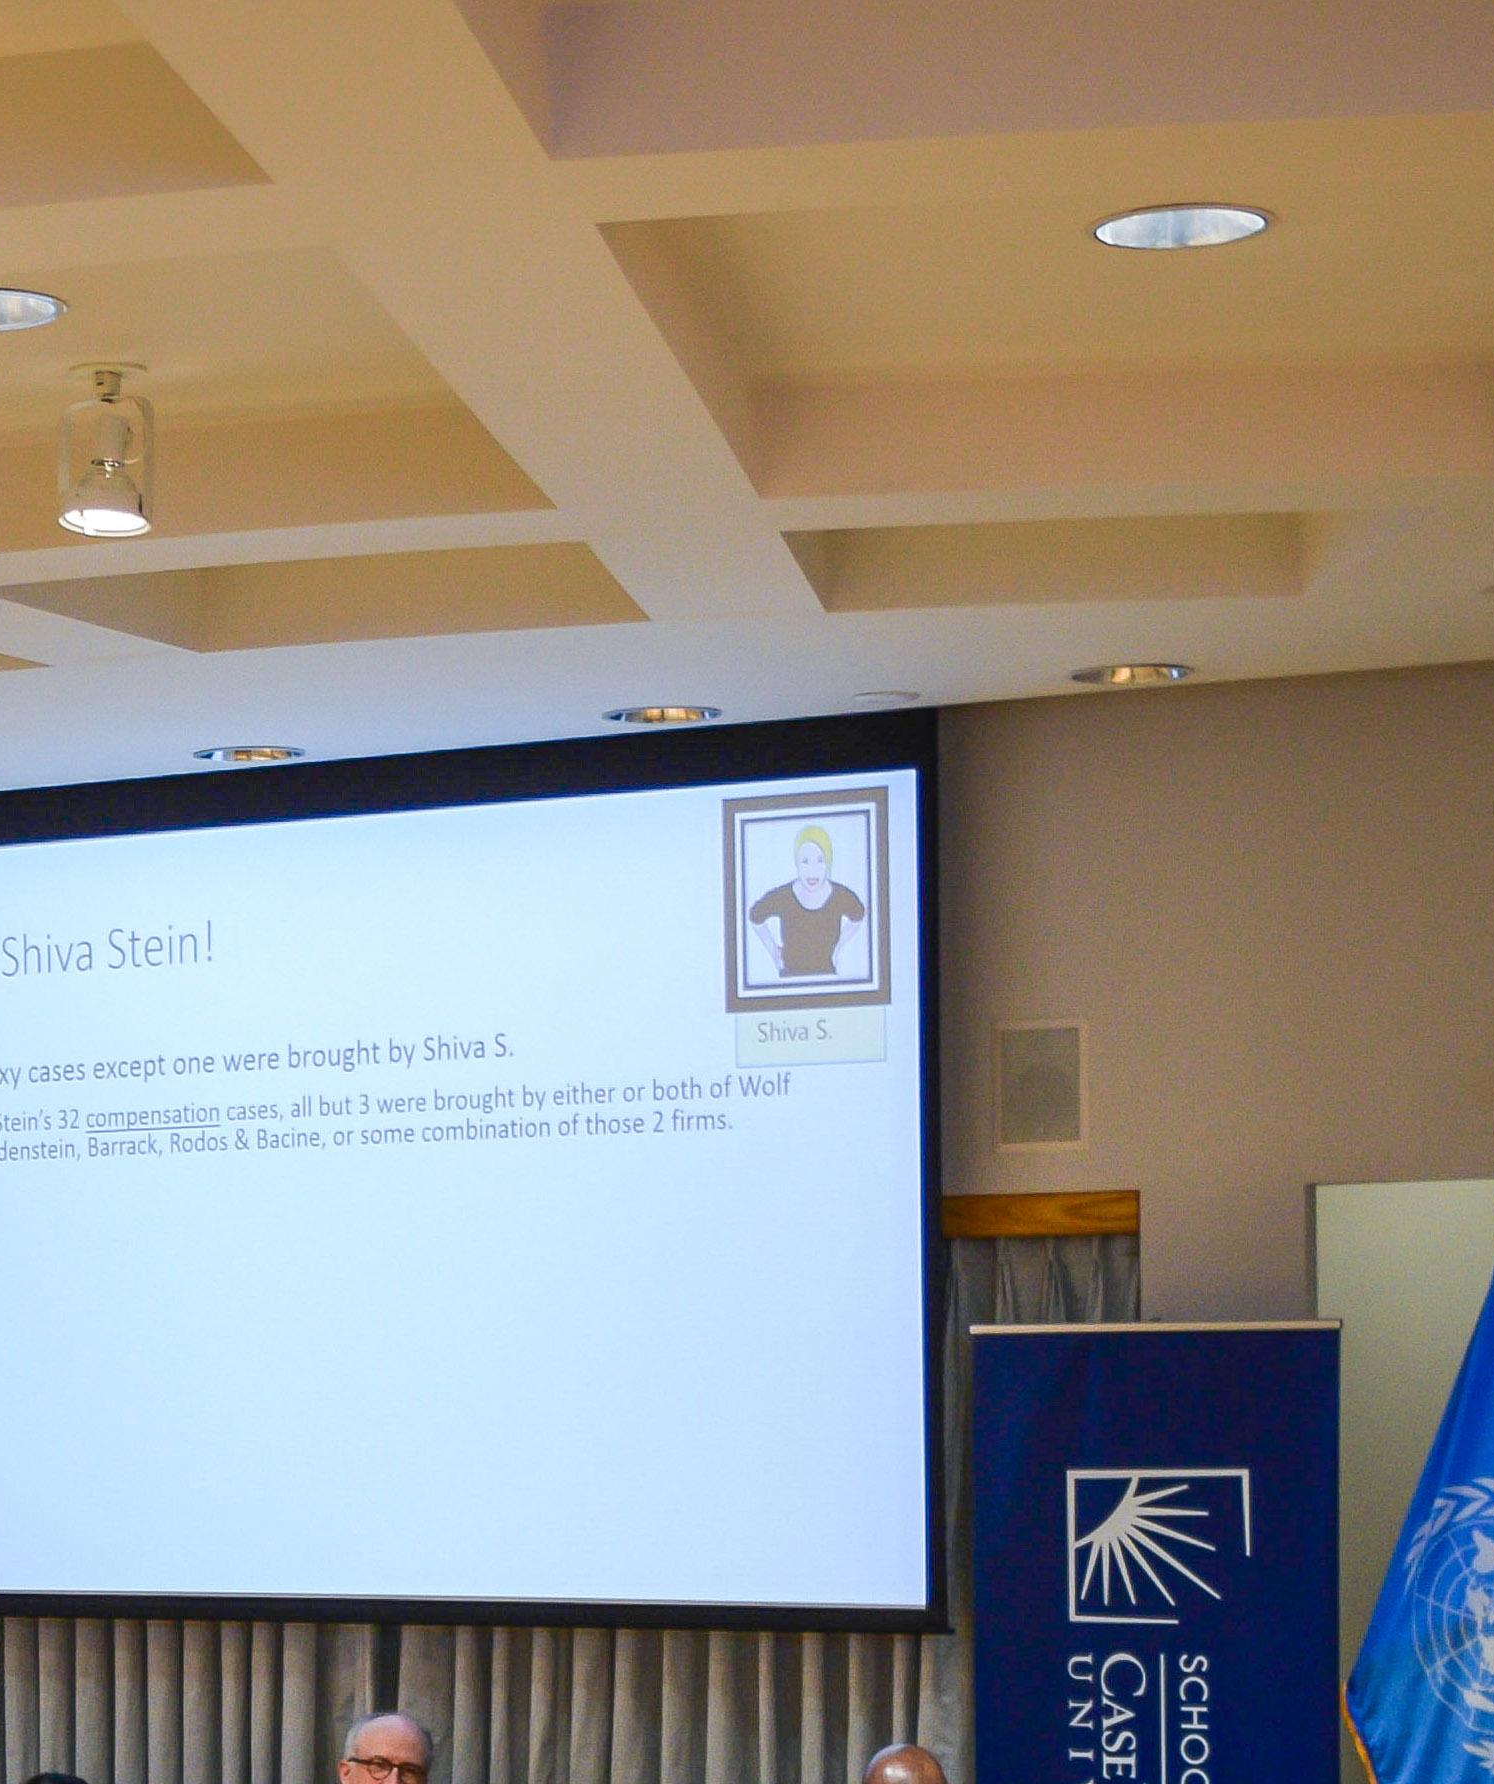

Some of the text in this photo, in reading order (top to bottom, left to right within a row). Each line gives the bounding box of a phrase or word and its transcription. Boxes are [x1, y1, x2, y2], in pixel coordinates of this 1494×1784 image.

[1, 933, 93, 977] Shiva
[107, 919, 212, 969] Stein!
[757, 1018, 834, 1043] Shiva S.
[28, 1062, 86, 1083] cases
[92, 1054, 166, 1082] except
[172, 1055, 215, 1075] one
[223, 1051, 280, 1073] were
[288, 1040, 380, 1072] brought
[389, 1038, 415, 1069] by
[422, 1035, 486, 1062] Shiva
[494, 1033, 514, 1058] S.
[58, 1109, 80, 1130] 32
[86, 1102, 220, 1131] compensation
[226, 1102, 284, 1122] cases,
[290, 1096, 312, 1118] all
[319, 1095, 351, 1116] but
[358, 1094, 370, 1114] 3
[376, 1095, 427, 1113] were
[433, 1086, 515, 1113] brought
[522, 1084, 547, 1111] by
[553, 1082, 616, 1105] either
[622, 1085, 646, 1102] or
[652, 1077, 702, 1101] both
[710, 1075, 732, 1098] of
[738, 1072, 791, 1097] Wolf
[87, 1133, 163, 1158] Barrack,
[170, 1130, 228, 1153] Rodos
[234, 1127, 250, 1150] &
[256, 1127, 327, 1150] Bacine,
[333, 1129, 354, 1146] or
[360, 1127, 415, 1145] some
[421, 1117, 551, 1143] combination
[558, 1114, 580, 1137] of
[586, 1112, 645, 1136] those
[651, 1111, 664, 1133] 2
[672, 1109, 733, 1132] firms.
